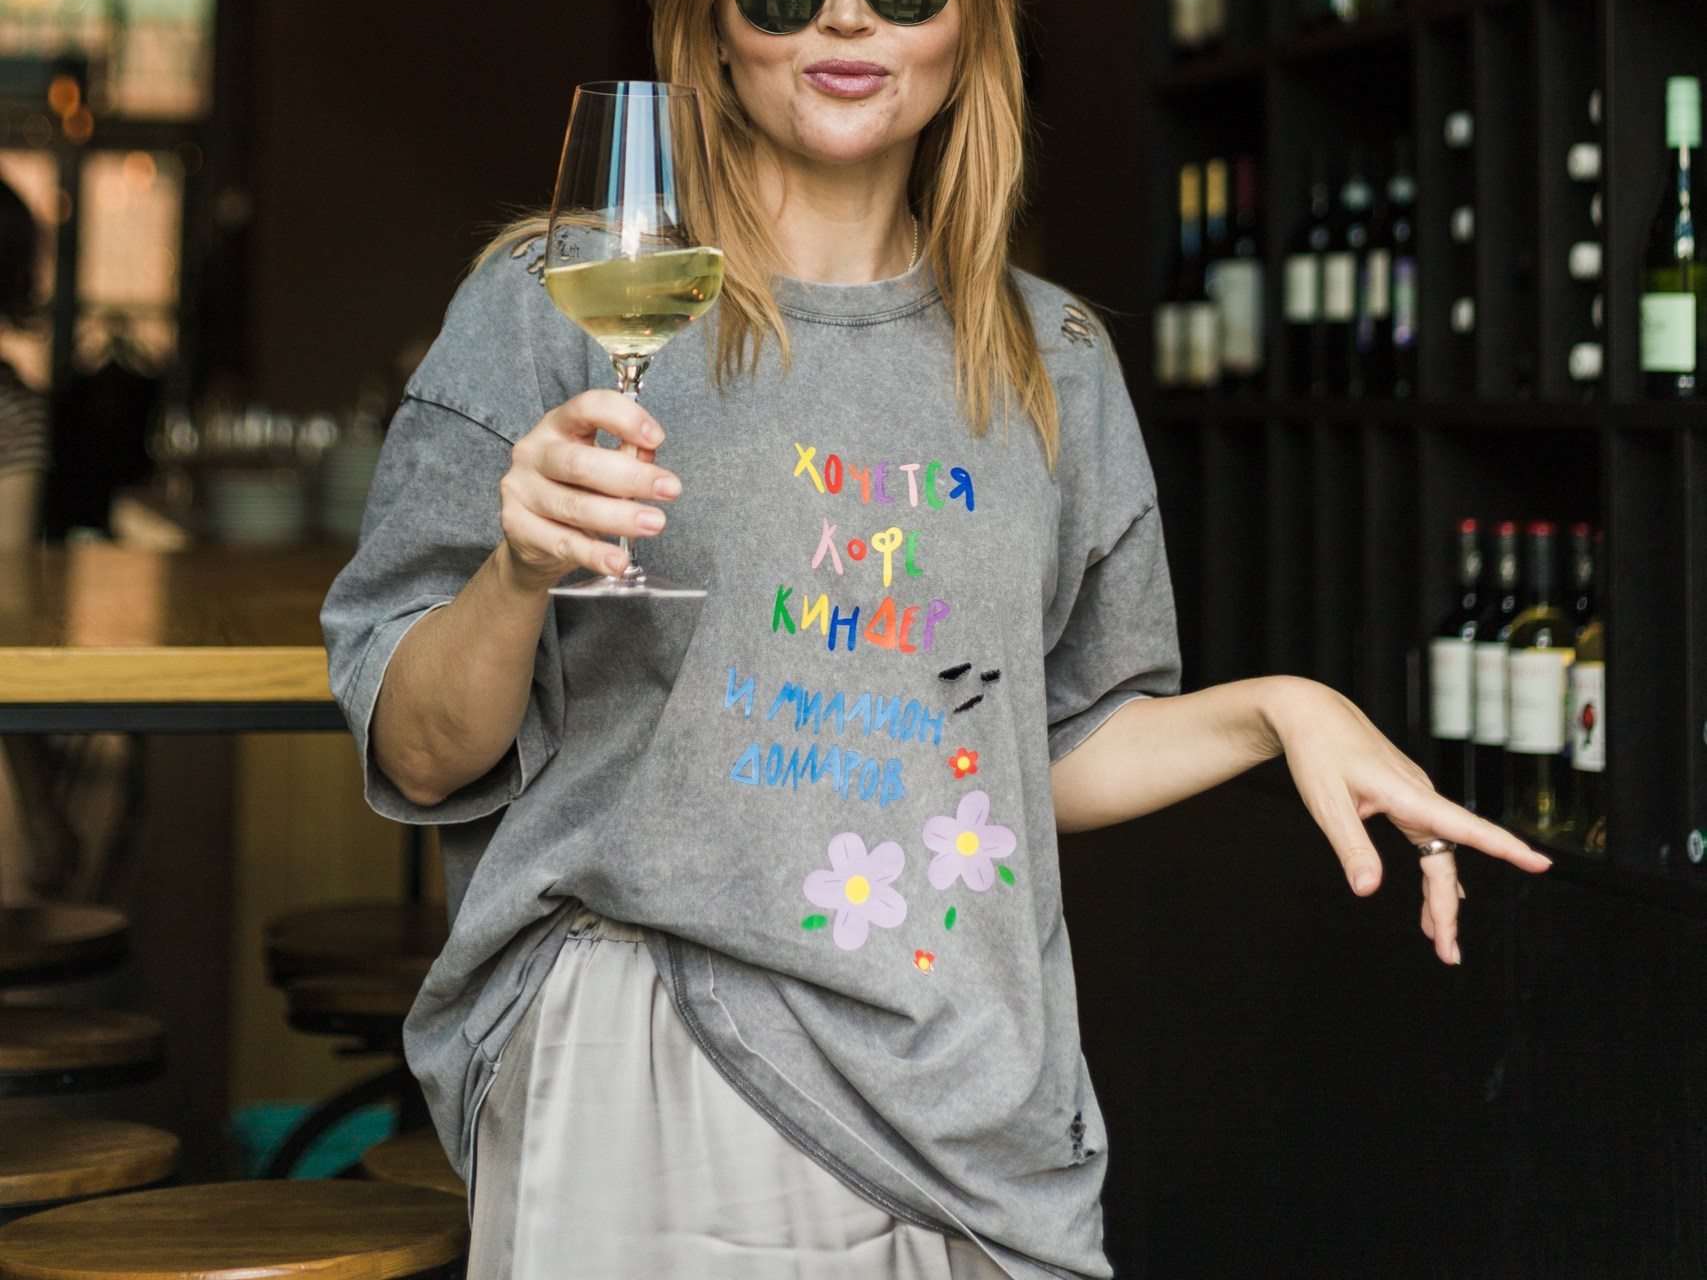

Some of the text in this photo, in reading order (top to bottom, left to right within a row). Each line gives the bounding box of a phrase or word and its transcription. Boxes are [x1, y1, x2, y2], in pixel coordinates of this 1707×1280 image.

[794, 442, 975, 512] ХОЧЕТСЯ
[772, 584, 950, 653] КИНДЕР
[725, 666, 944, 746] И МИЛЛИОН
[729, 741, 906, 809] ДОЛЛАРОВ
